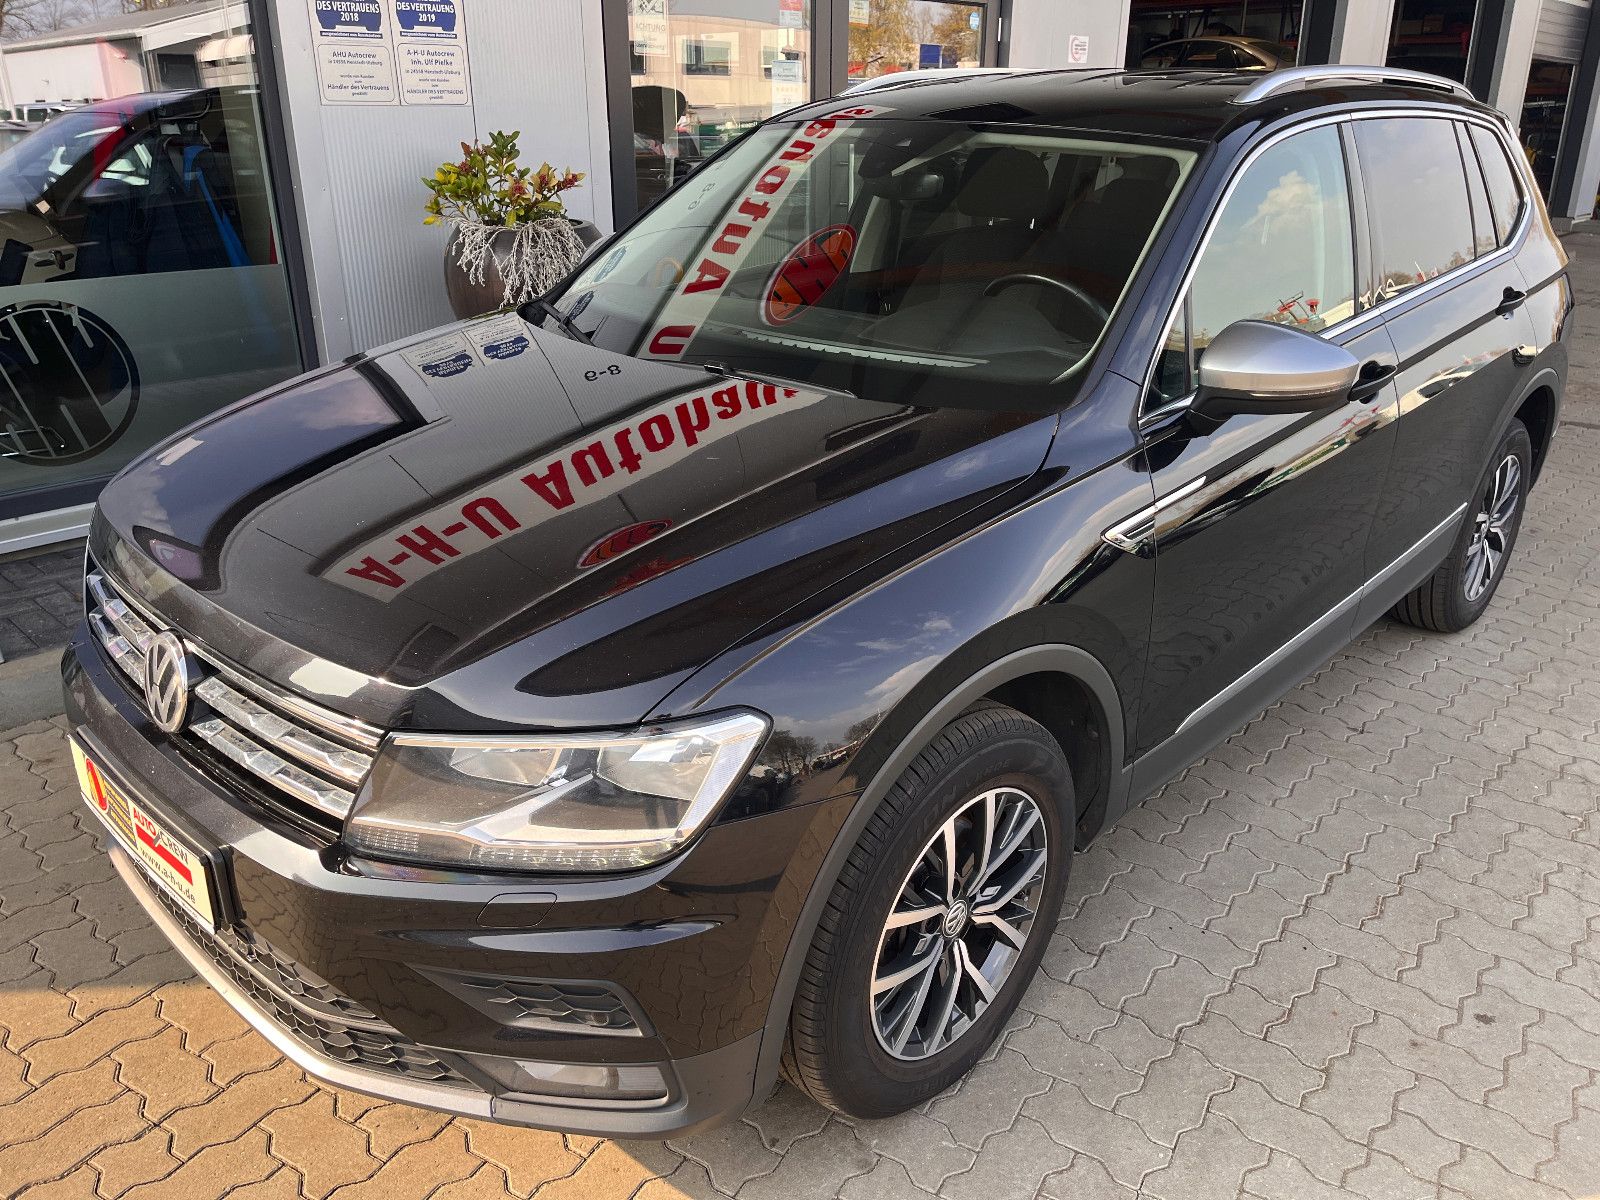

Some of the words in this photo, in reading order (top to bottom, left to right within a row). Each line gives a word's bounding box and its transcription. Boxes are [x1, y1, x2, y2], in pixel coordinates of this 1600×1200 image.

[316, 1, 331, 11] DES
[332, 2, 380, 13] VERTRAUENS
[396, 2, 411, 11] DES
[411, 3, 455, 13] VERTRAUENS
[340, 12, 359, 22] 2018
[418, 13, 436, 22] 2019
[406, 49, 425, 57] A-H-U
[426, 50, 455, 58] Autocrew
[133, 806, 157, 837] AUTO
[139, 847, 197, 905] www.a-h-u.de
